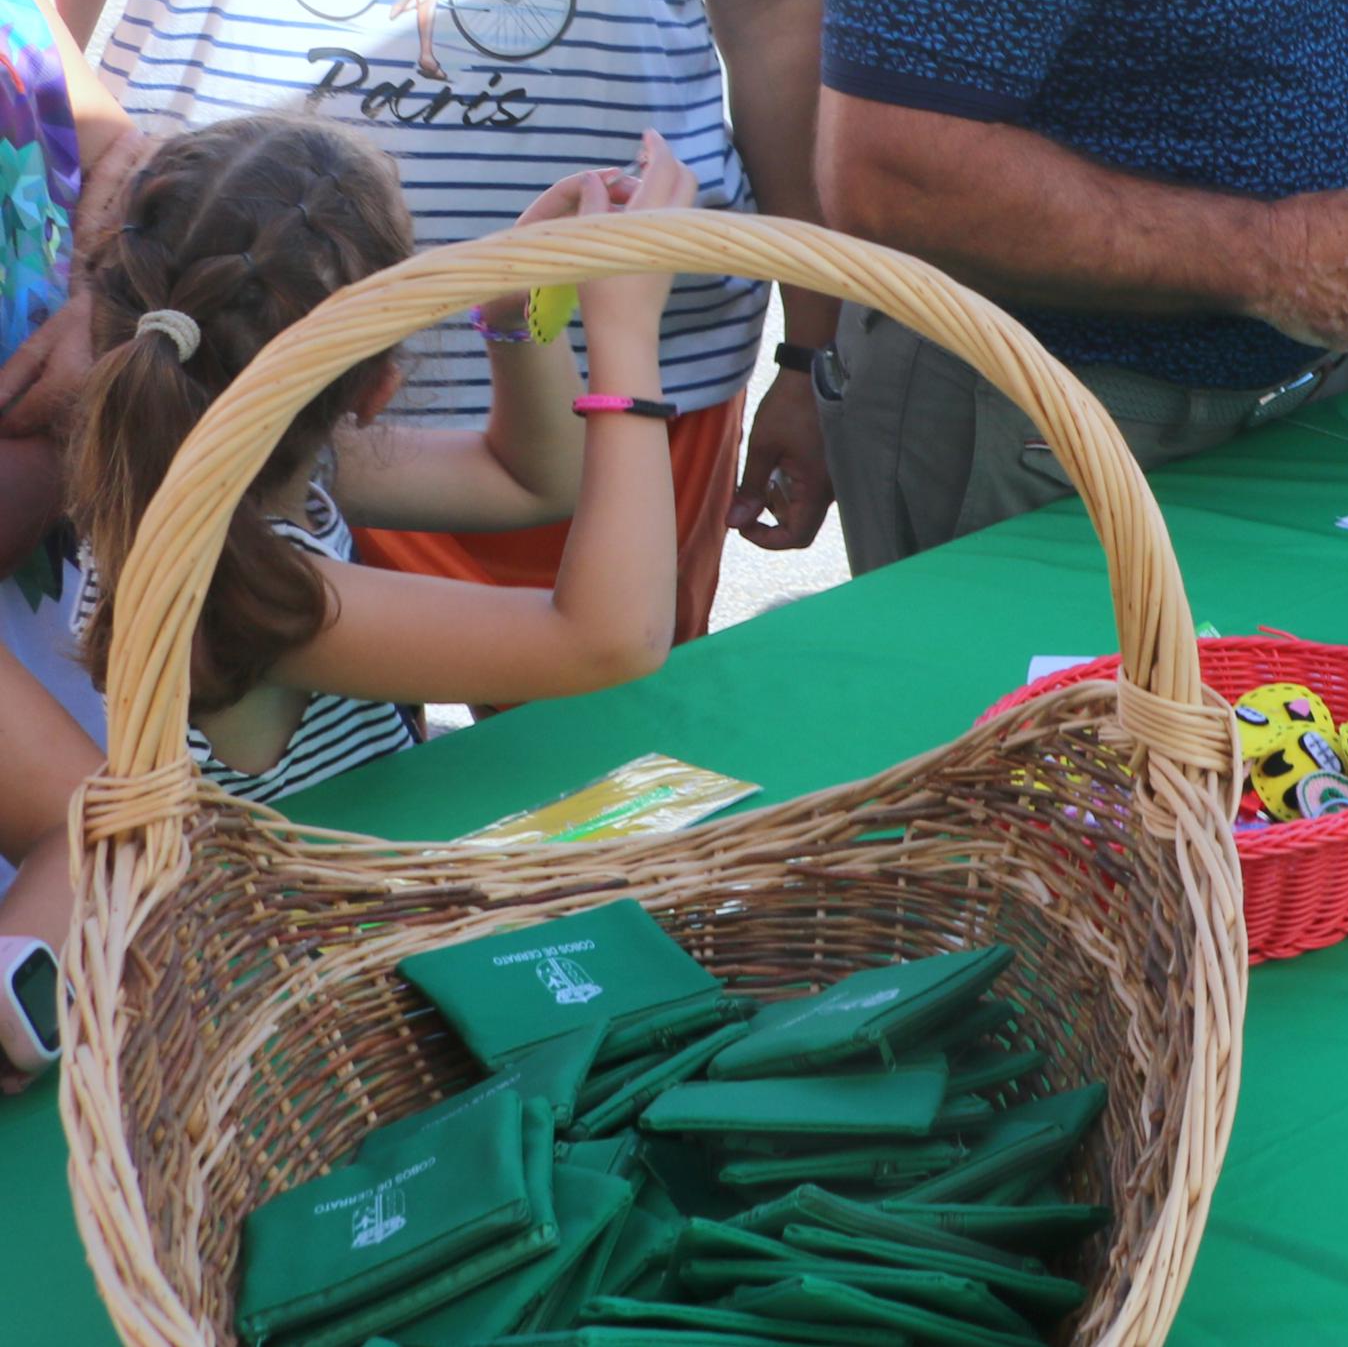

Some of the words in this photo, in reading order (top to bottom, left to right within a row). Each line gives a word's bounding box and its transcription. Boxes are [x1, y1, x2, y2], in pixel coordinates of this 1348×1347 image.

[305, 47, 533, 127] Paris
[493, 948, 543, 967] CERRATO
[542, 945, 559, 956] DE
[558, 939, 596, 955] COBOS
[394, 1156, 437, 1184] COBOS
[313, 1188, 374, 1215] CERRATO
